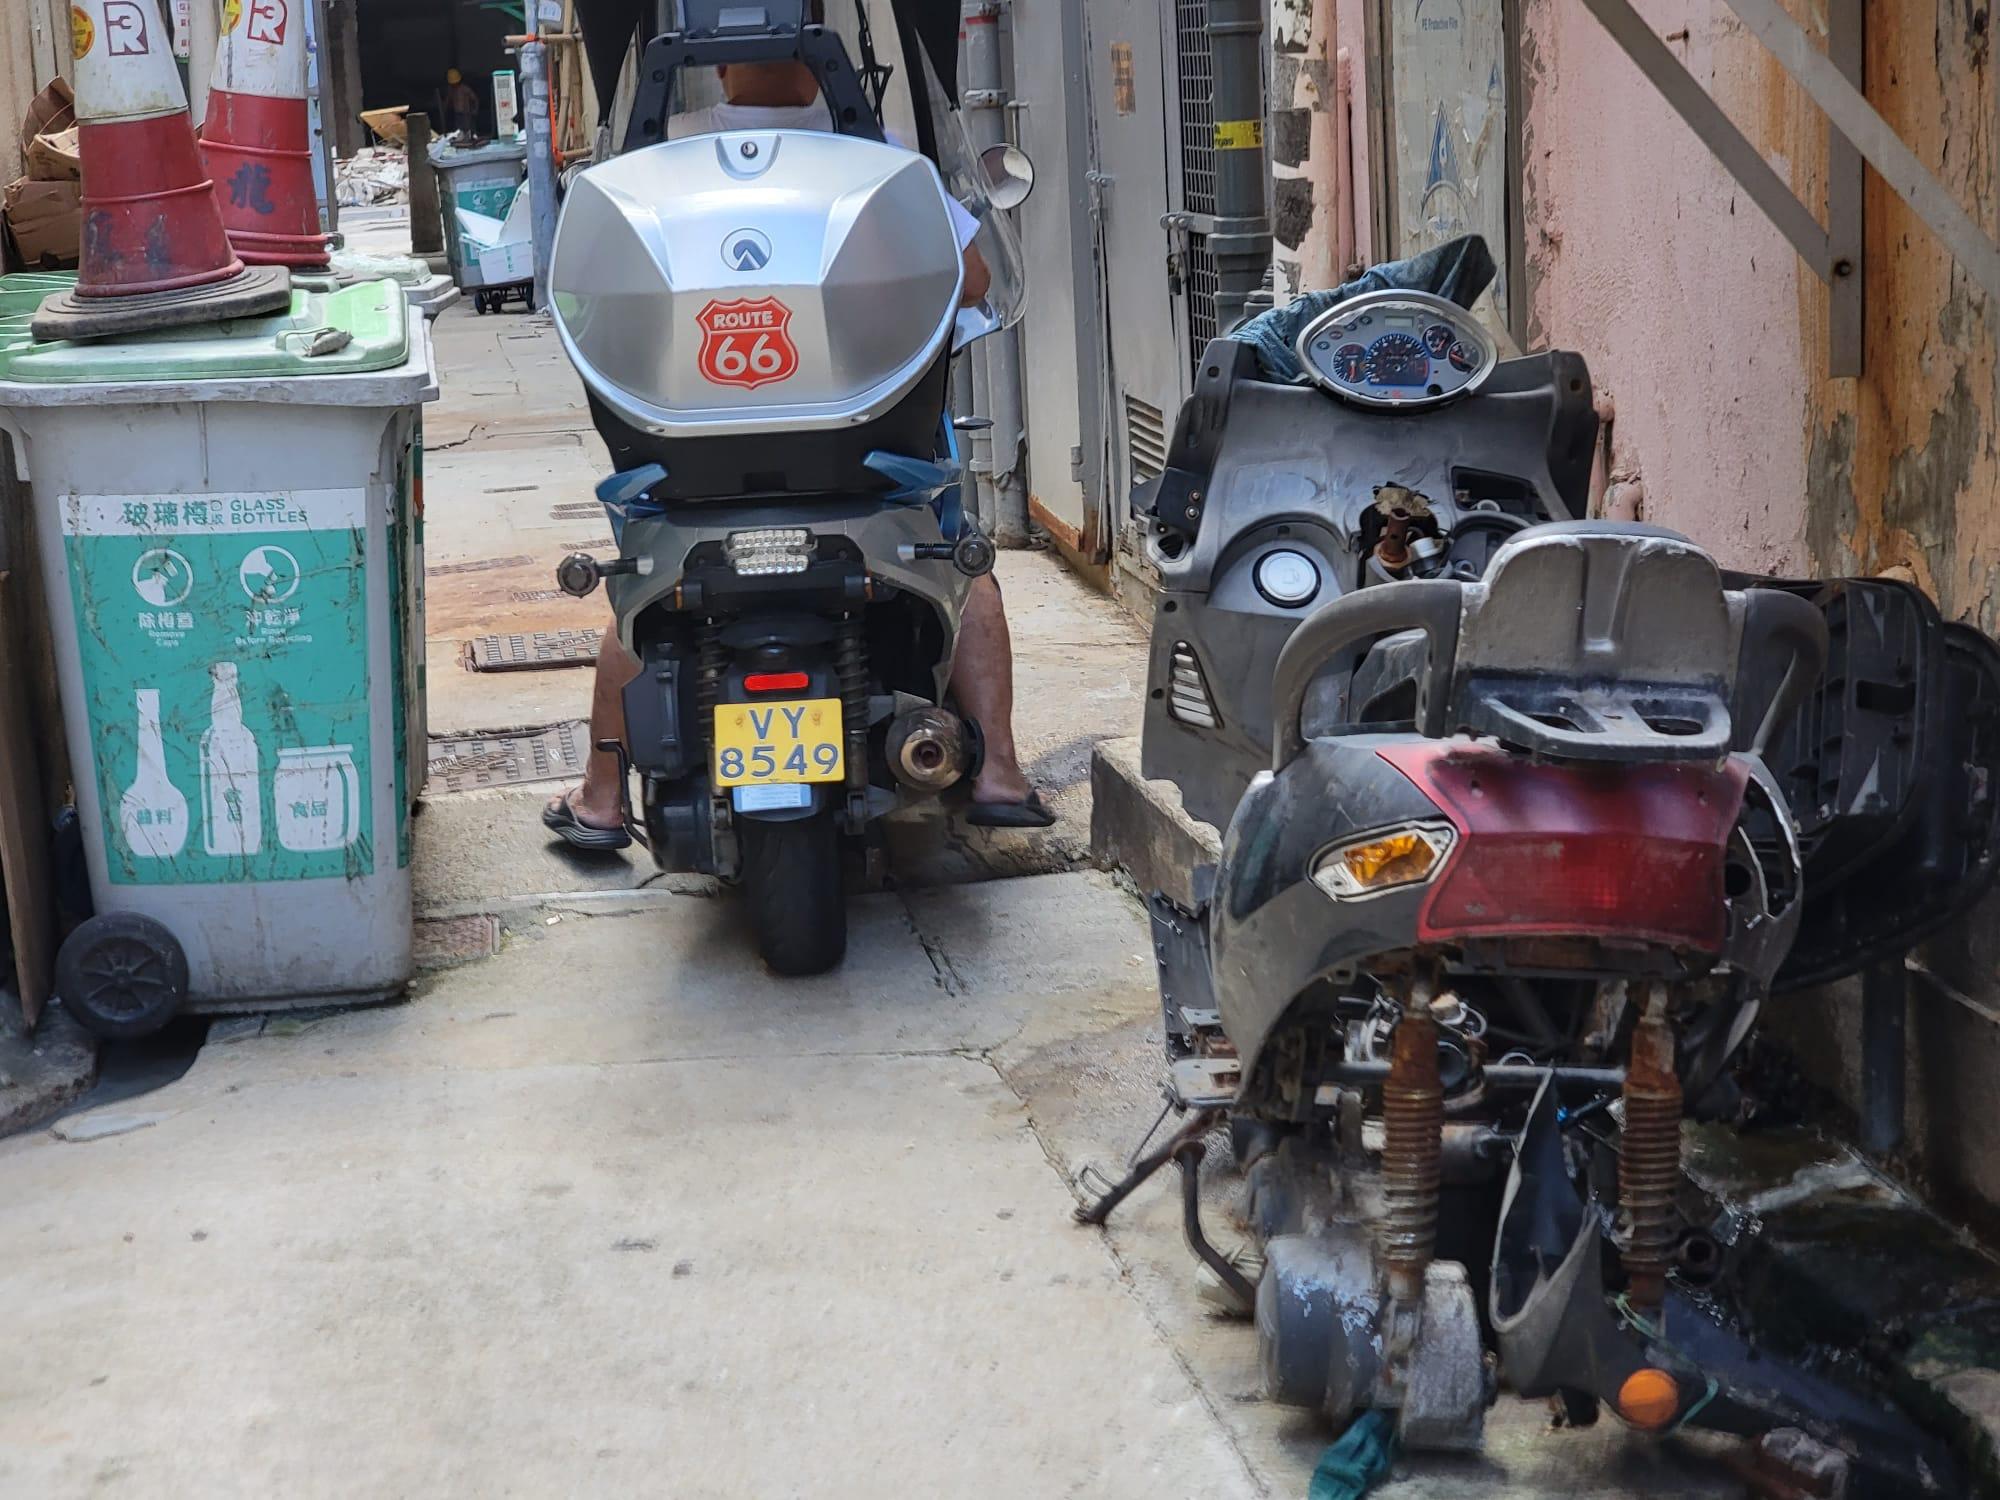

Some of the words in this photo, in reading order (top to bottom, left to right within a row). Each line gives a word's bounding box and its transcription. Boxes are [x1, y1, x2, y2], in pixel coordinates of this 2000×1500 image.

[713, 310, 774, 329] ROUTE
[715, 333, 782, 376] 66
[123, 500, 208, 526] 玻璃樽
[230, 498, 286, 512] GLASS
[231, 510, 308, 525] BOTTLES
[748, 707, 806, 740] VY
[720, 742, 839, 779] 8549
